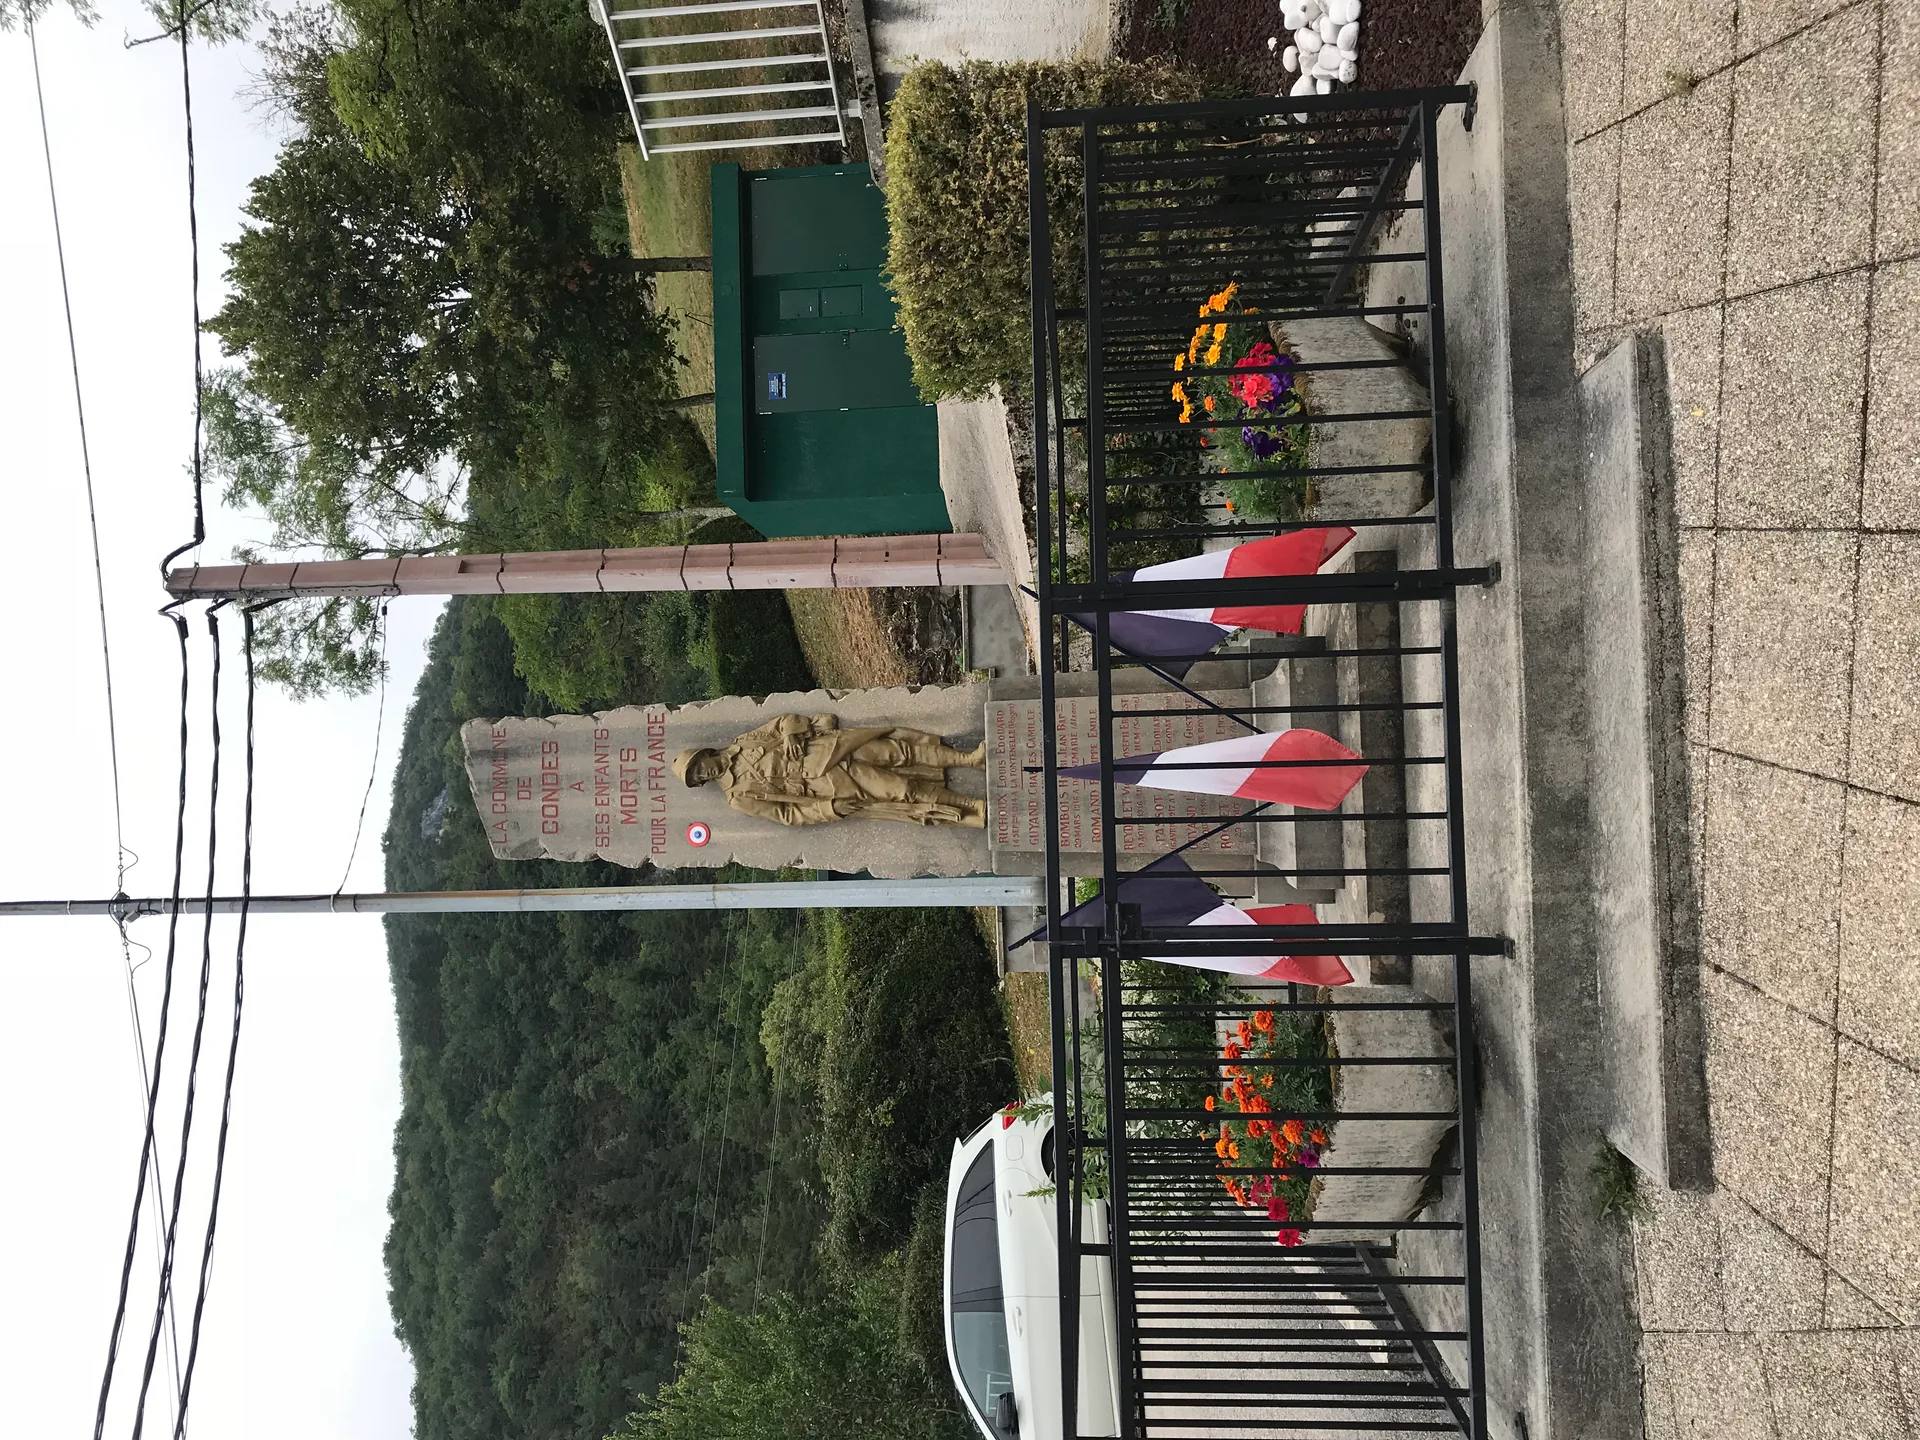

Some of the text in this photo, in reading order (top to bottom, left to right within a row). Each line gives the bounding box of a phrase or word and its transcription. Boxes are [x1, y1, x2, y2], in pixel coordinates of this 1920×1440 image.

[1184, 697, 1194, 738] GUSTVE
[1008, 730, 1016, 776] FONTENELLE
[492, 727, 508, 844] LA COMMUNE
[516, 777, 532, 800] DE
[542, 740, 559, 834] CONDES
[570, 780, 584, 792] A
[594, 728, 610, 848] SES ENFANTS
[620, 747, 638, 825] MORTS
[647, 712, 667, 854] POUR LA FRANCE
[1010, 778, 1018, 788] LA
[998, 793, 1008, 844] RICHOUX
[1028, 800, 1040, 846] GUYAND
[1060, 792, 1070, 847] BOMBOIS
[1090, 790, 1102, 842] ROMAND
